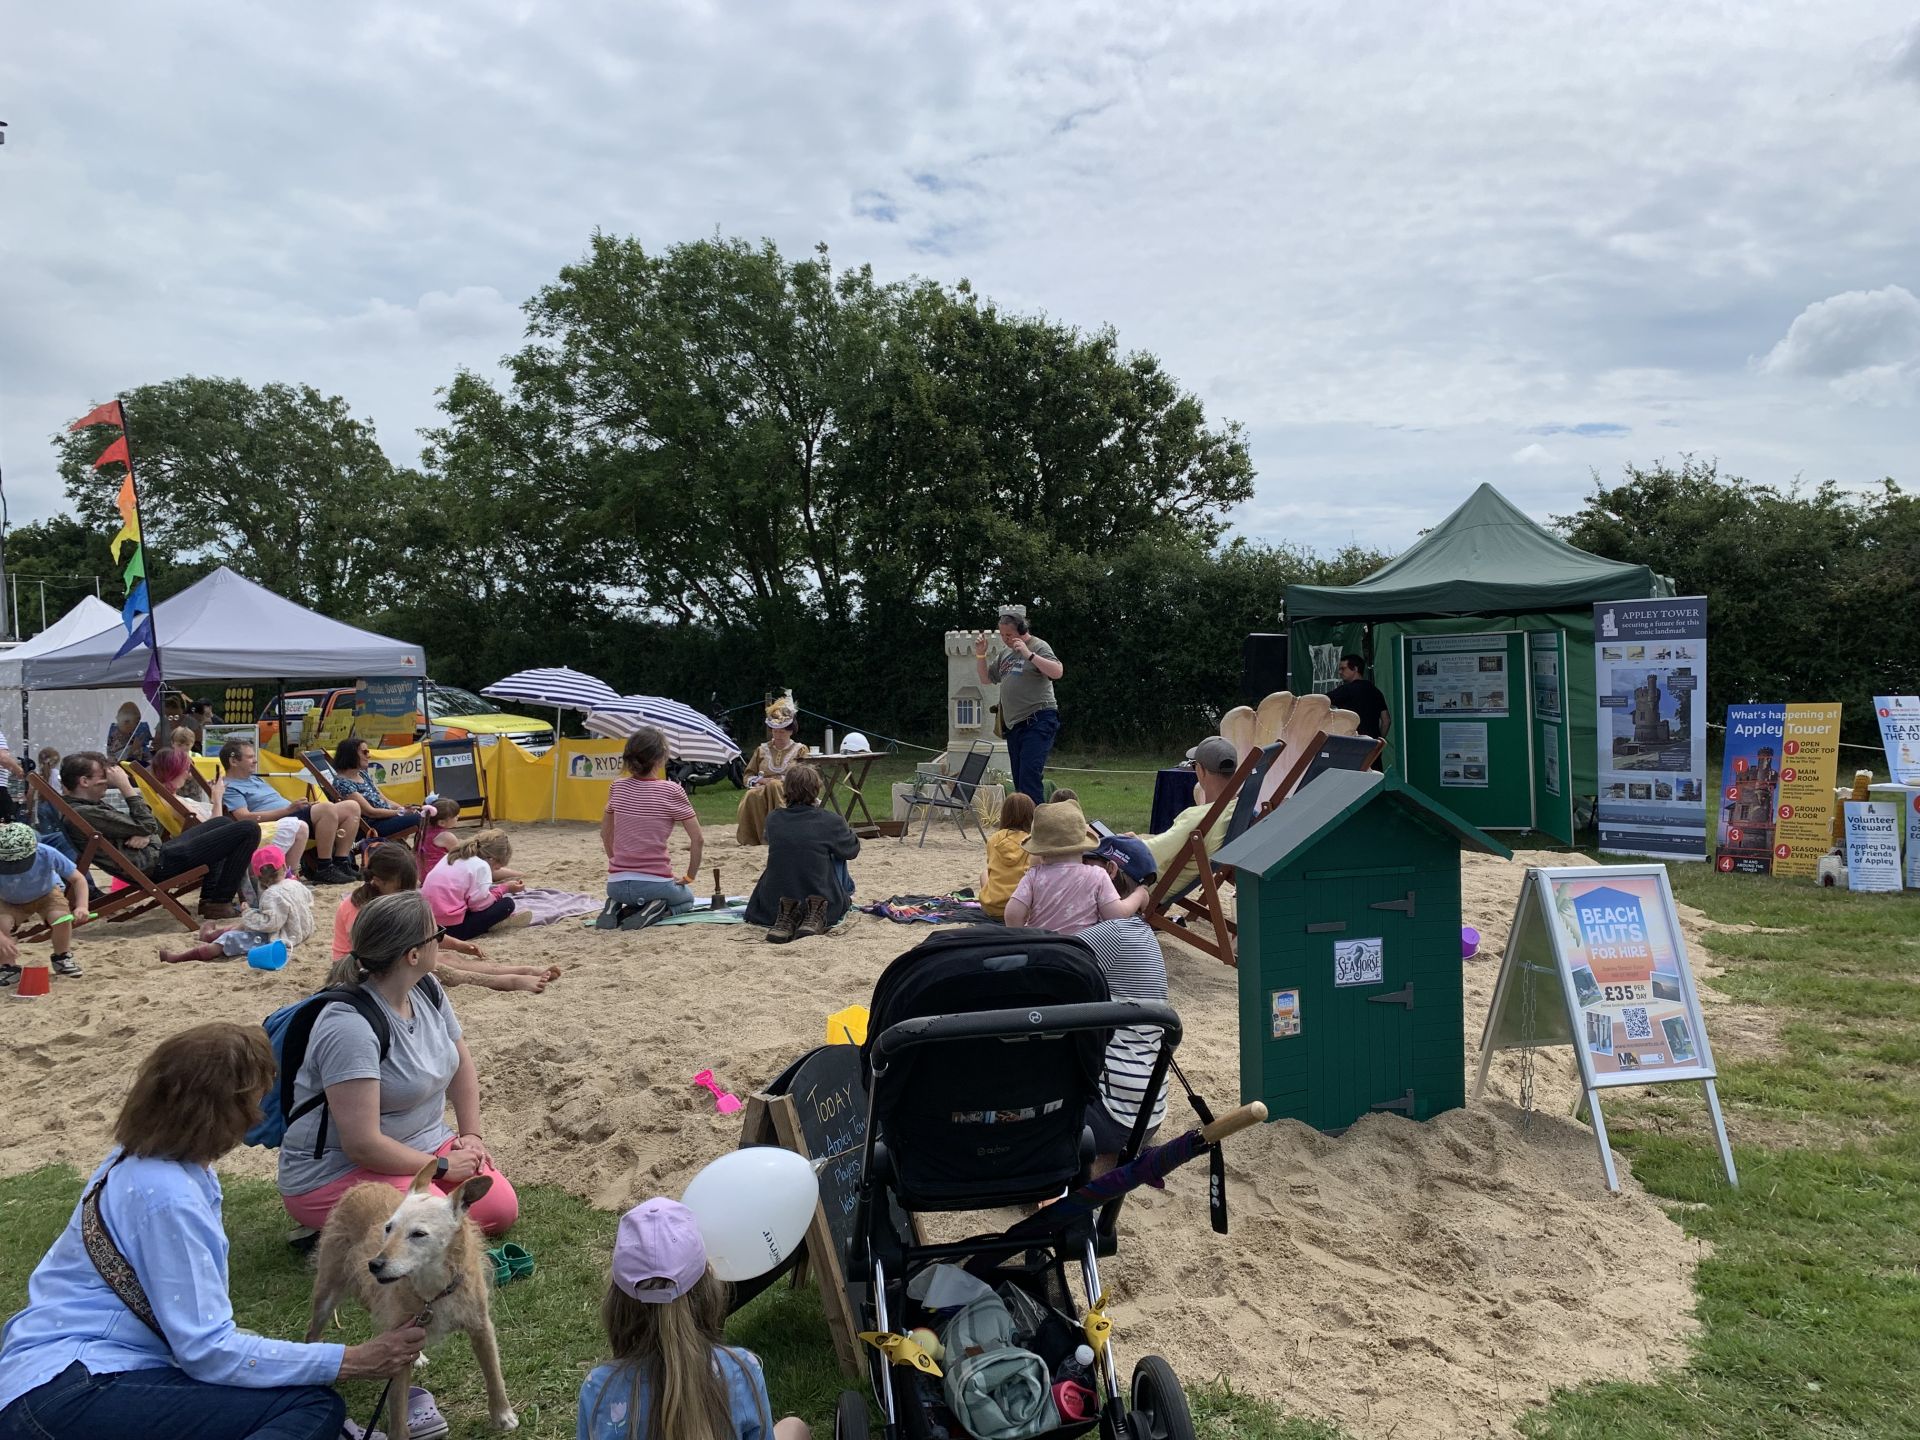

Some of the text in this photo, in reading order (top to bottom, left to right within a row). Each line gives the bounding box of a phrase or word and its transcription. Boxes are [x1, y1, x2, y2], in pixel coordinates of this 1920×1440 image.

[1622, 608, 1700, 620] APPLEY TOWER
[1731, 710, 1837, 720] What's happening at
[1734, 723, 1832, 738] Appley Tower
[1884, 732, 1904, 740] THE
[1788, 742, 1794, 753] 1
[452, 754, 472, 762] RYDE
[595, 756, 622, 770] RYDE
[390, 758, 422, 776] RYDE
[1784, 770, 1792, 780] 2
[1729, 788, 1737, 798] 2
[1781, 806, 1790, 818] 3
[1852, 824, 1892, 832] Steward
[1732, 830, 1738, 840] 3
[1778, 846, 1786, 856] 4
[1850, 843, 1896, 852] Appley Day
[1722, 858, 1730, 870] 4
[1865, 858, 1894, 866] Appley
[1581, 906, 1639, 924] BEACH
[1586, 924, 1644, 944] HUTS
[1592, 946, 1648, 960] FOR HIRE
[1605, 985, 1634, 1001] £35
